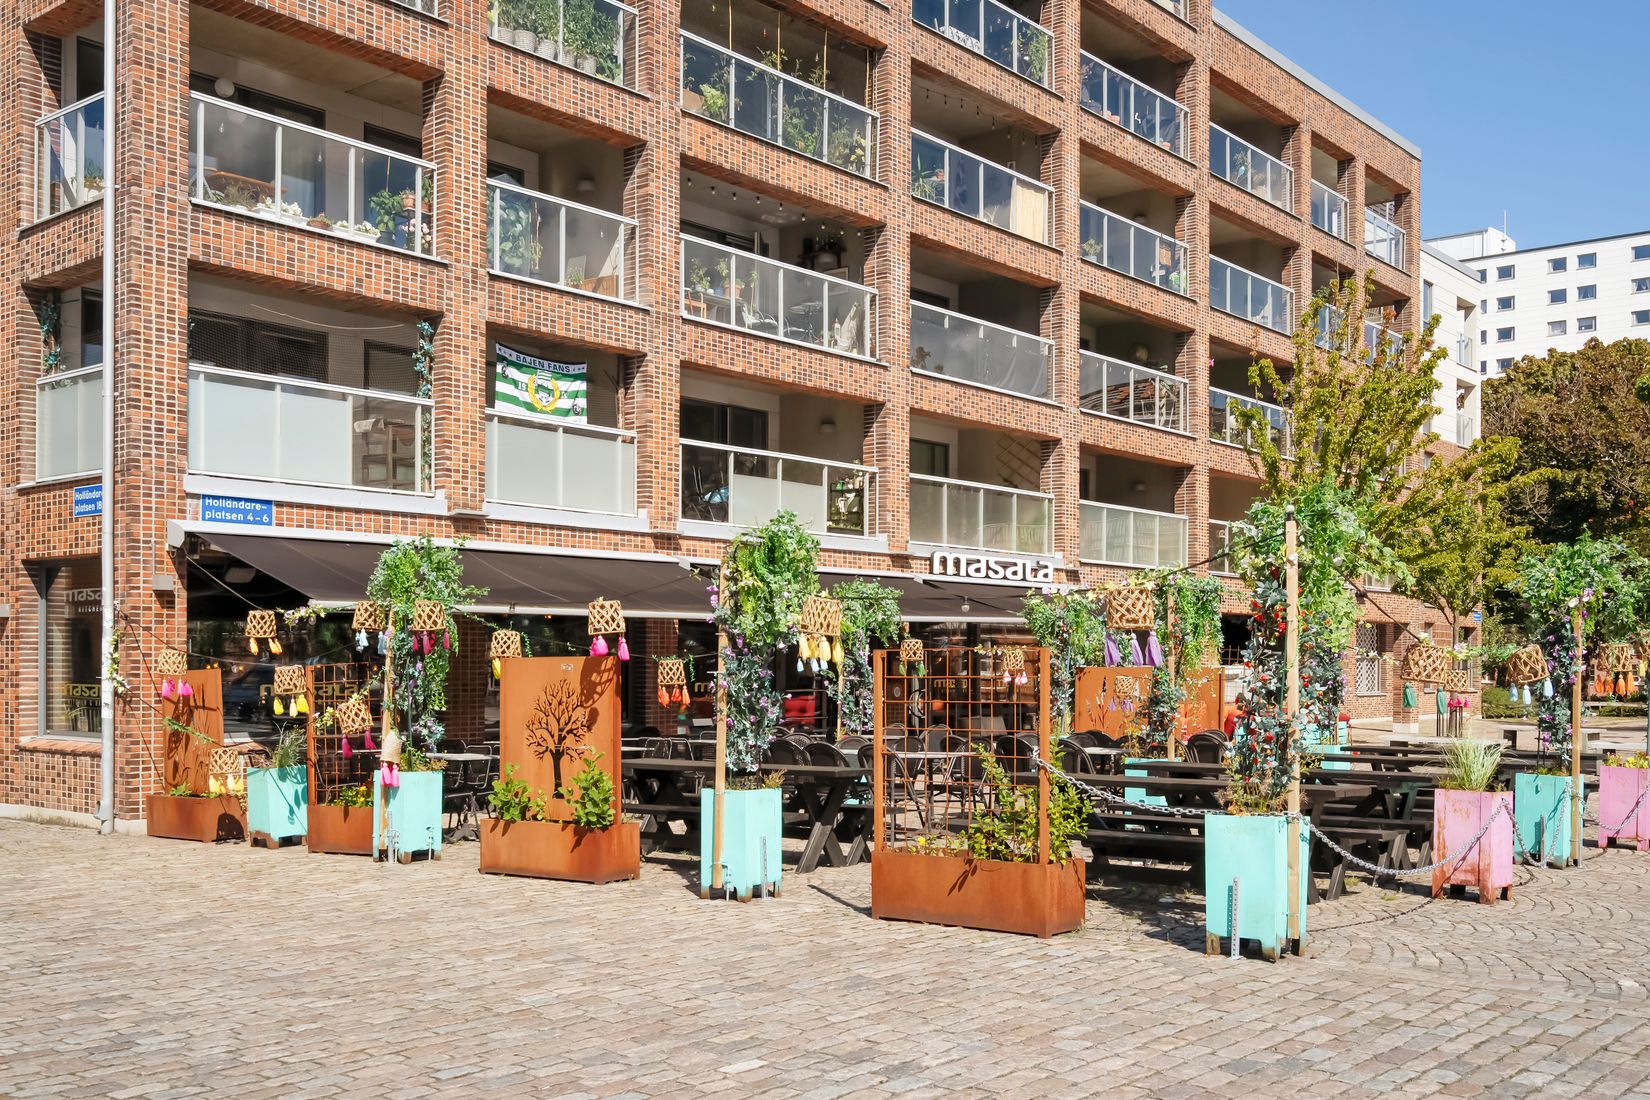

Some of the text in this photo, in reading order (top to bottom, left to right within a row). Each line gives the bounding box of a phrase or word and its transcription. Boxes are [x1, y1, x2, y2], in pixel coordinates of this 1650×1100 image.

[515, 353, 571, 373] BAJEN FANS
[75, 489, 102, 501] Holländar
[75, 503, 96, 515] platsen
[205, 496, 268, 511] Holländare-
[205, 509, 244, 520] platsen
[931, 551, 1054, 582] masala
[64, 587, 102, 602] masa
[64, 683, 102, 697] masa
